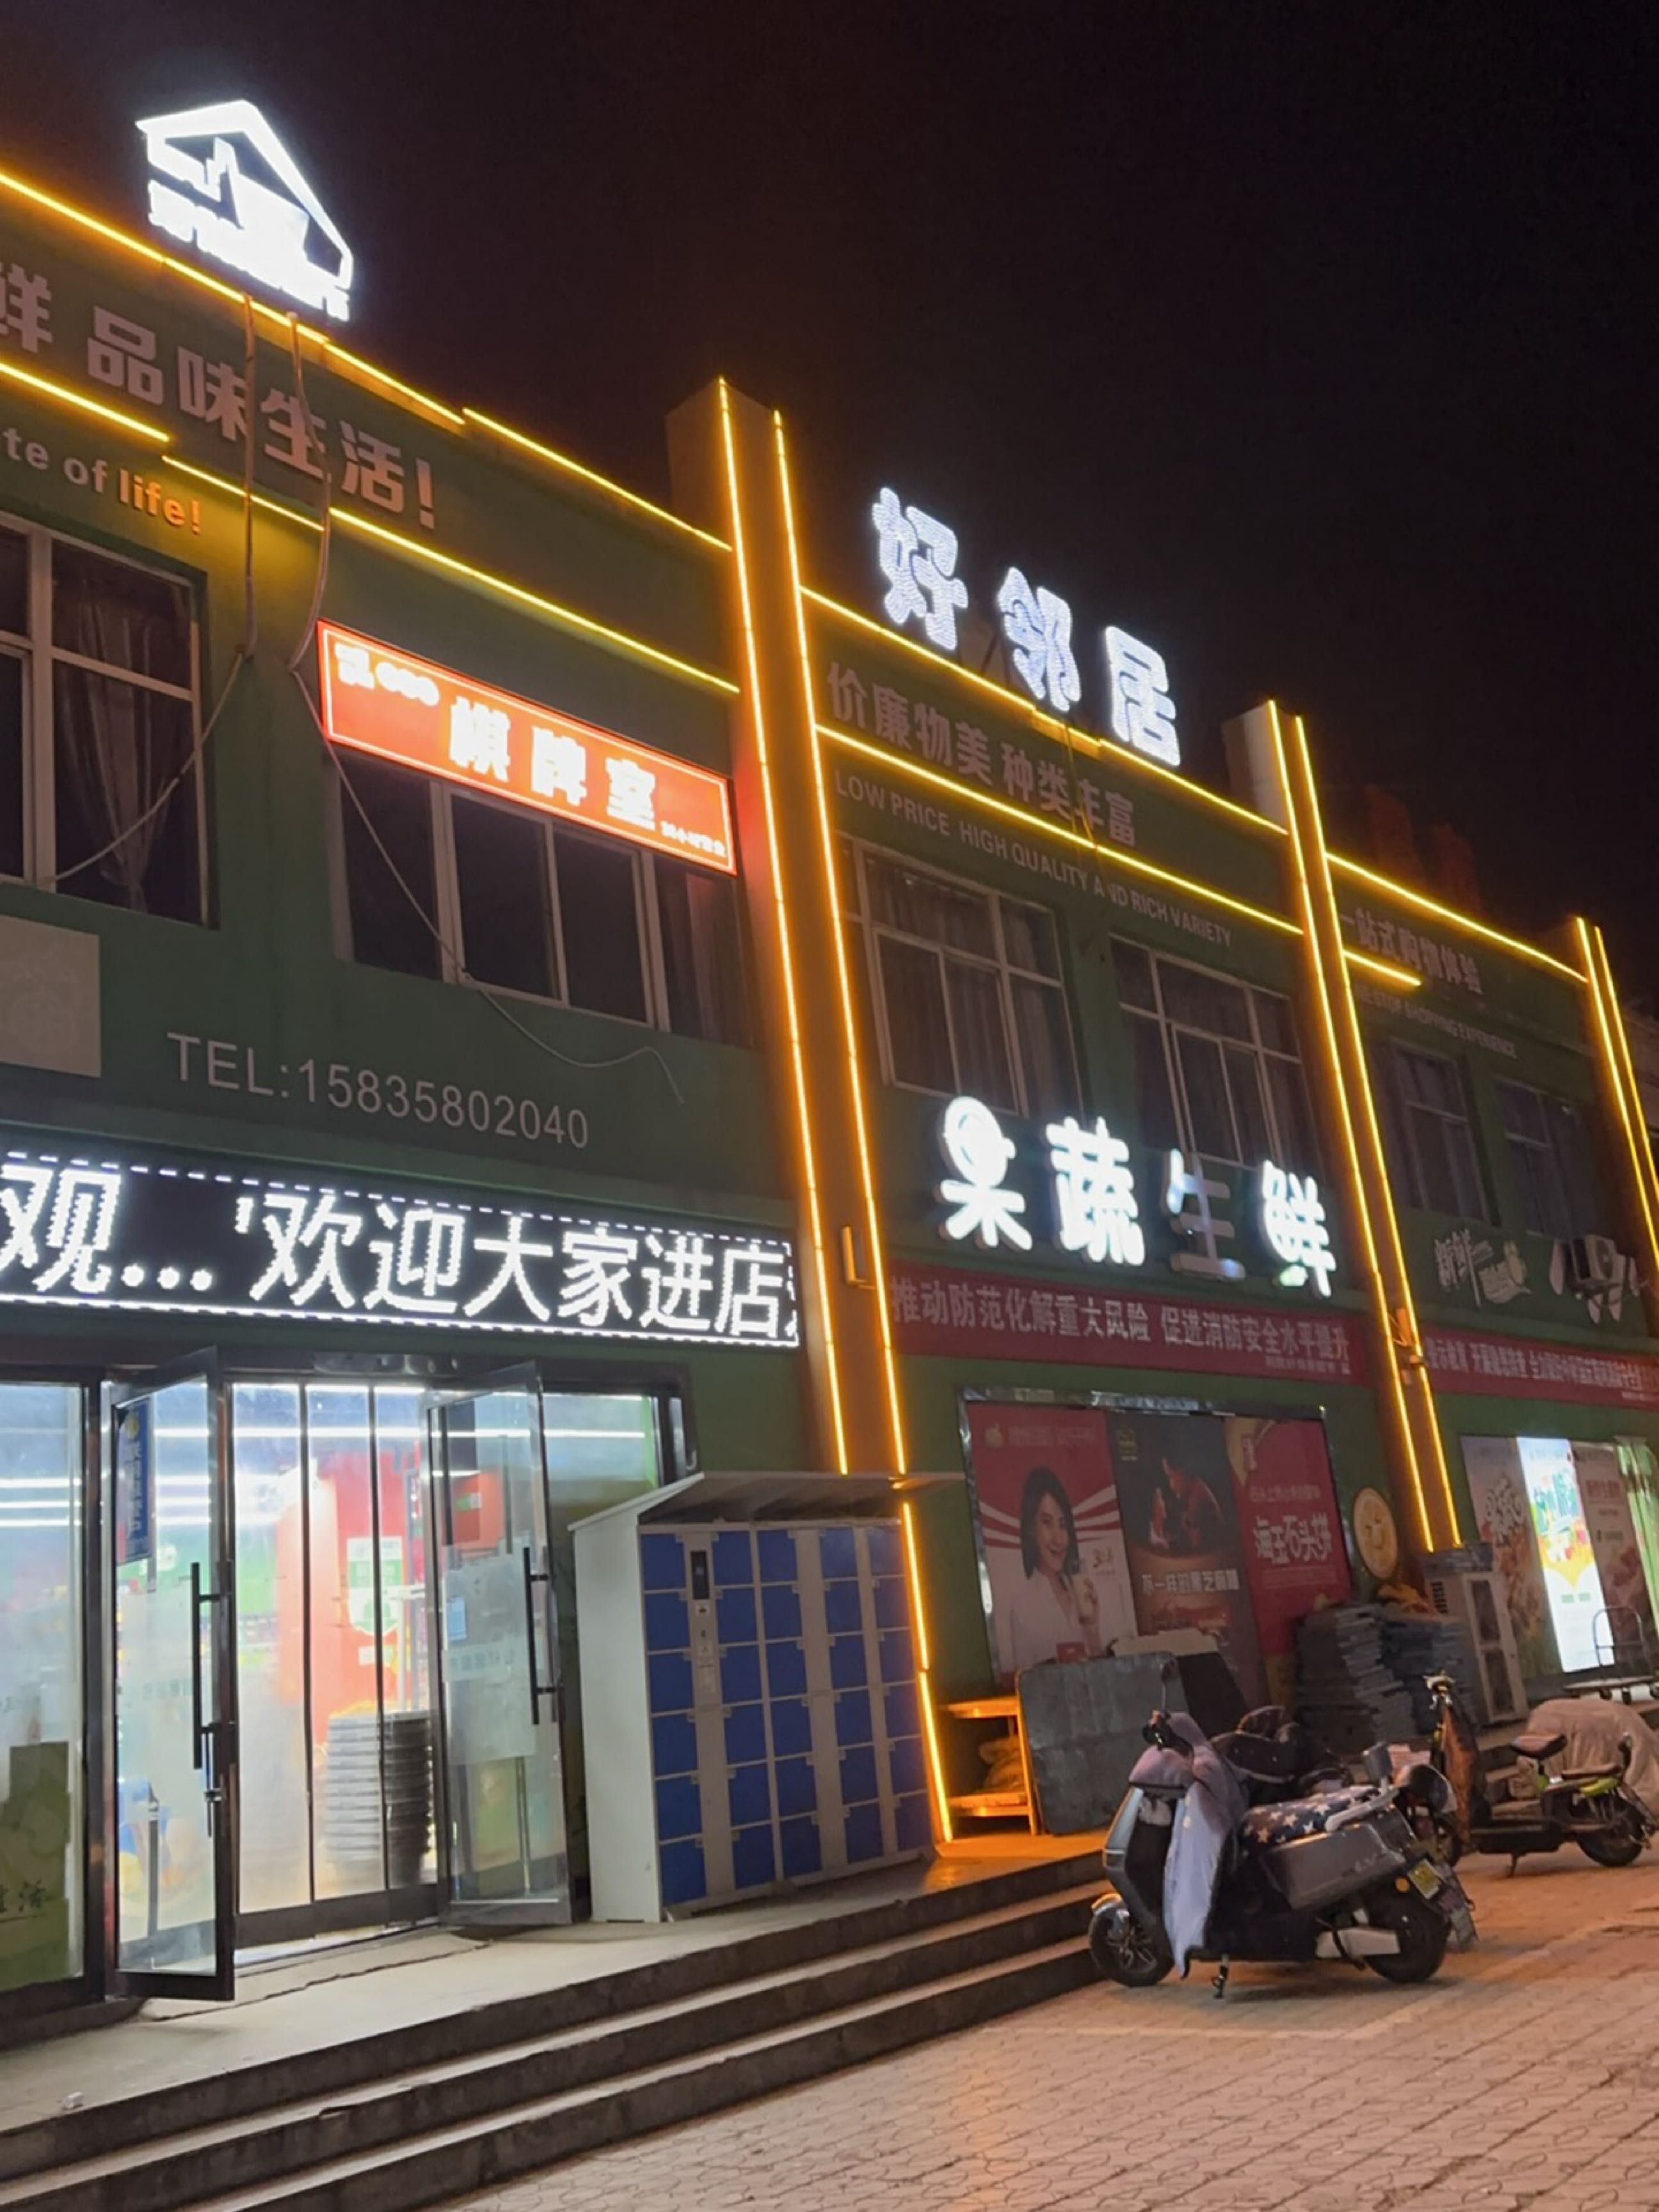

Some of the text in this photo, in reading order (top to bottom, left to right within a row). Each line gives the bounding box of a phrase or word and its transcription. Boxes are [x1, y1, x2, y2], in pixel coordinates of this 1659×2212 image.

[64, 457, 108, 493] of
[118, 468, 200, 536] life!
[871, 486, 1180, 767] 好邻居
[449, 695, 655, 831] 棋牌室
[827, 662, 1136, 847] 价廉物美 种类丰富
[835, 769, 886, 812] LOW
[890, 791, 951, 837] PRICE
[959, 821, 1010, 861] HIGH
[1011, 842, 1089, 893] QUALITY
[1130, 890, 1169, 924] RICH
[1169, 906, 1233, 948] VARIETY
[167, 1031, 588, 1148] TEL:15835802040
[933, 1096, 1337, 1298] 果蔬生鲜
[890, 1276, 1151, 1342] 推动防范化解重大风险
